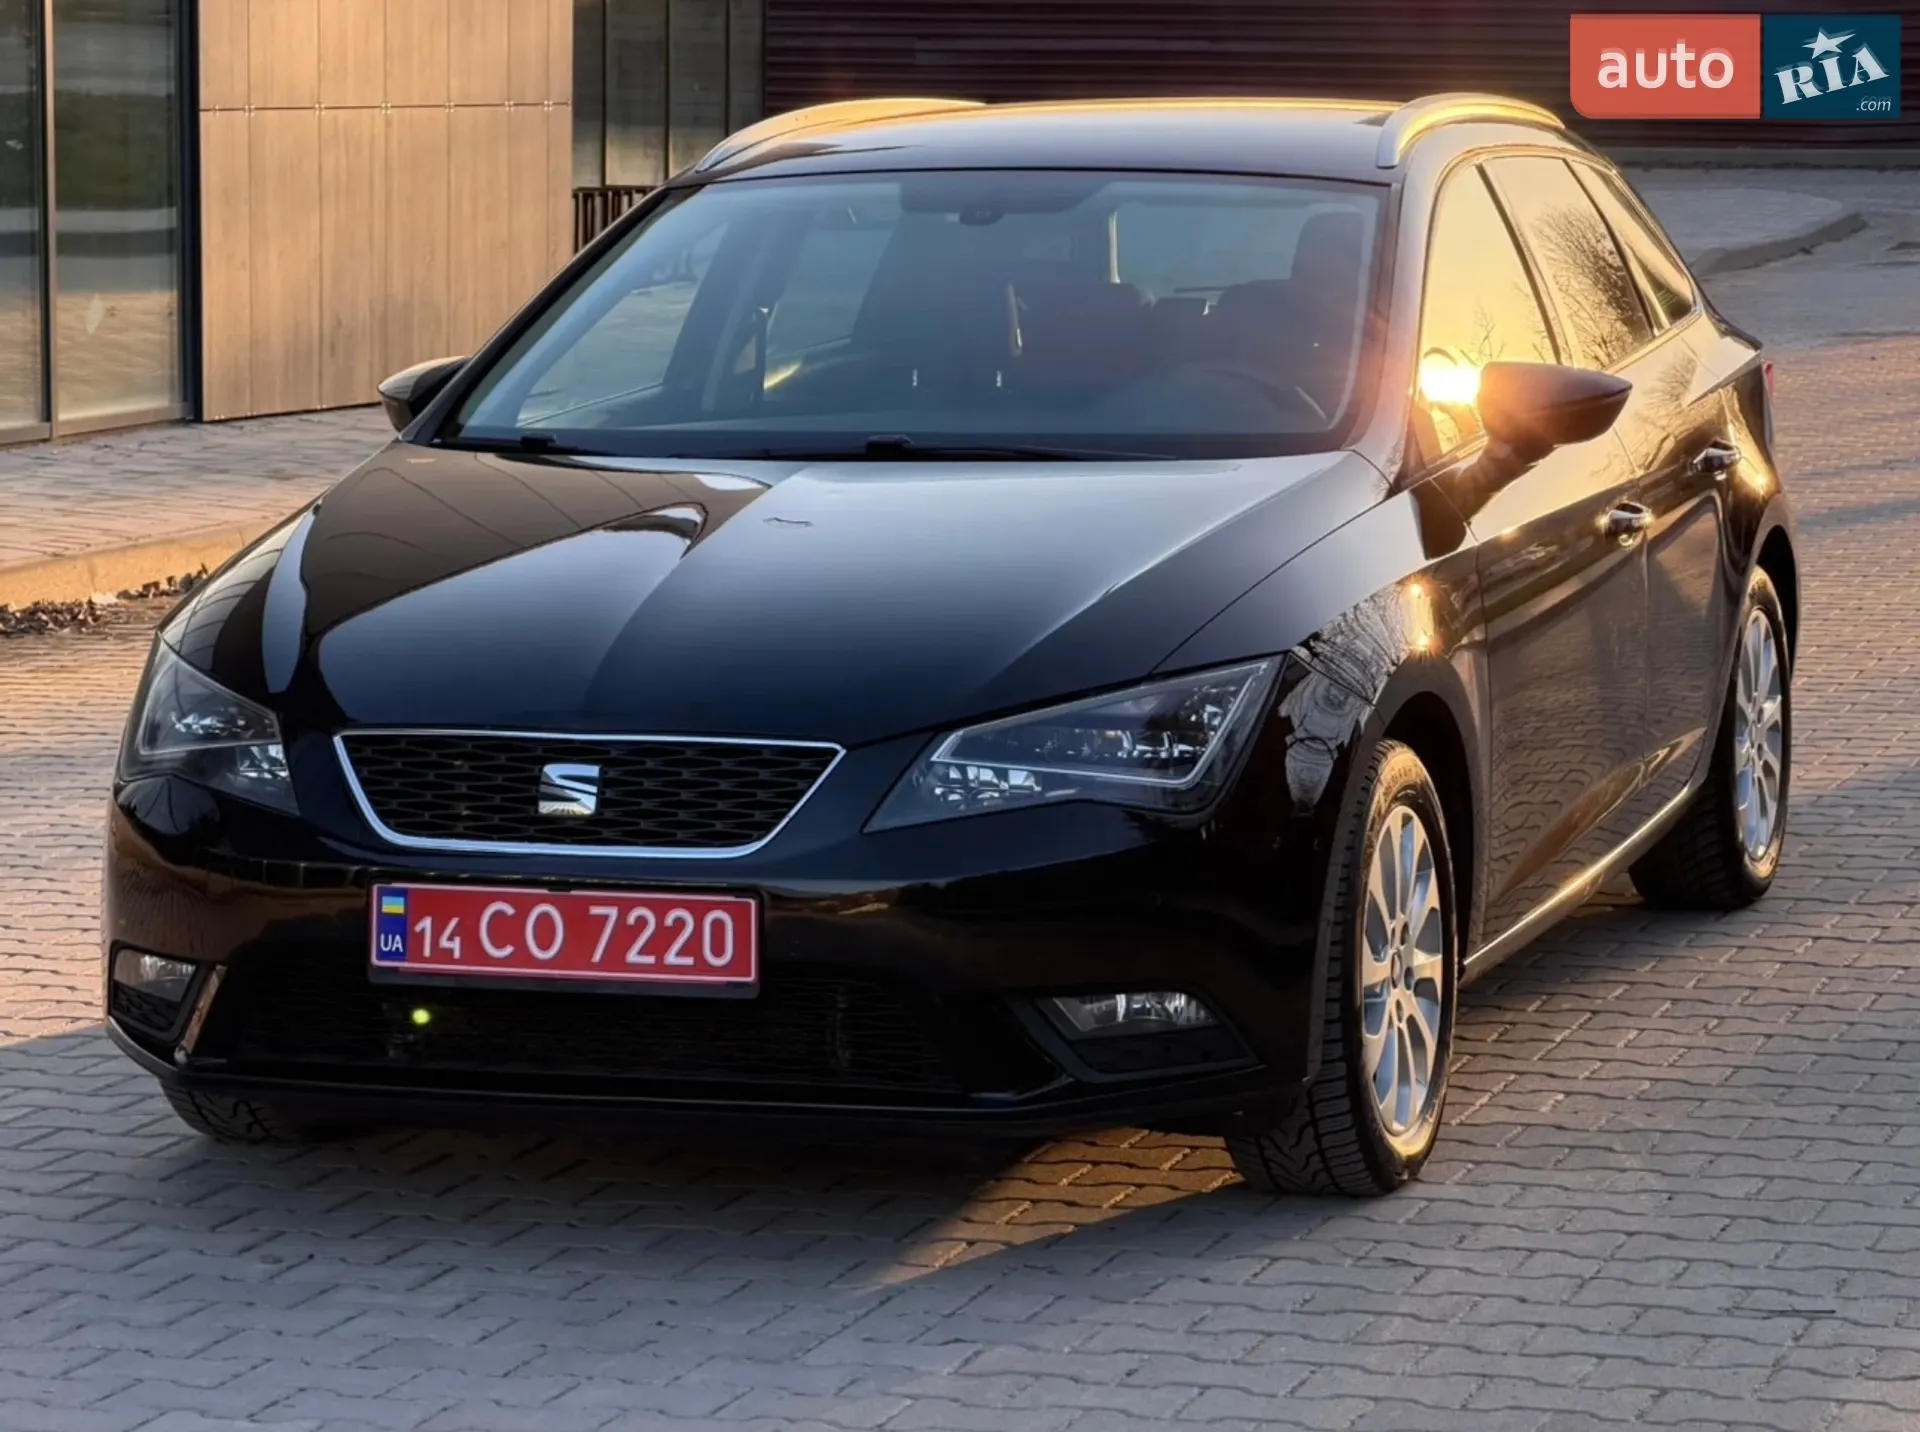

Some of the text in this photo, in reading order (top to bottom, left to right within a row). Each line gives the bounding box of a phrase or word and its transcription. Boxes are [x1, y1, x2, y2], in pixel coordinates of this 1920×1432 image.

[380, 932, 403, 953] UA
[413, 901, 735, 967] 14 CO 7220
